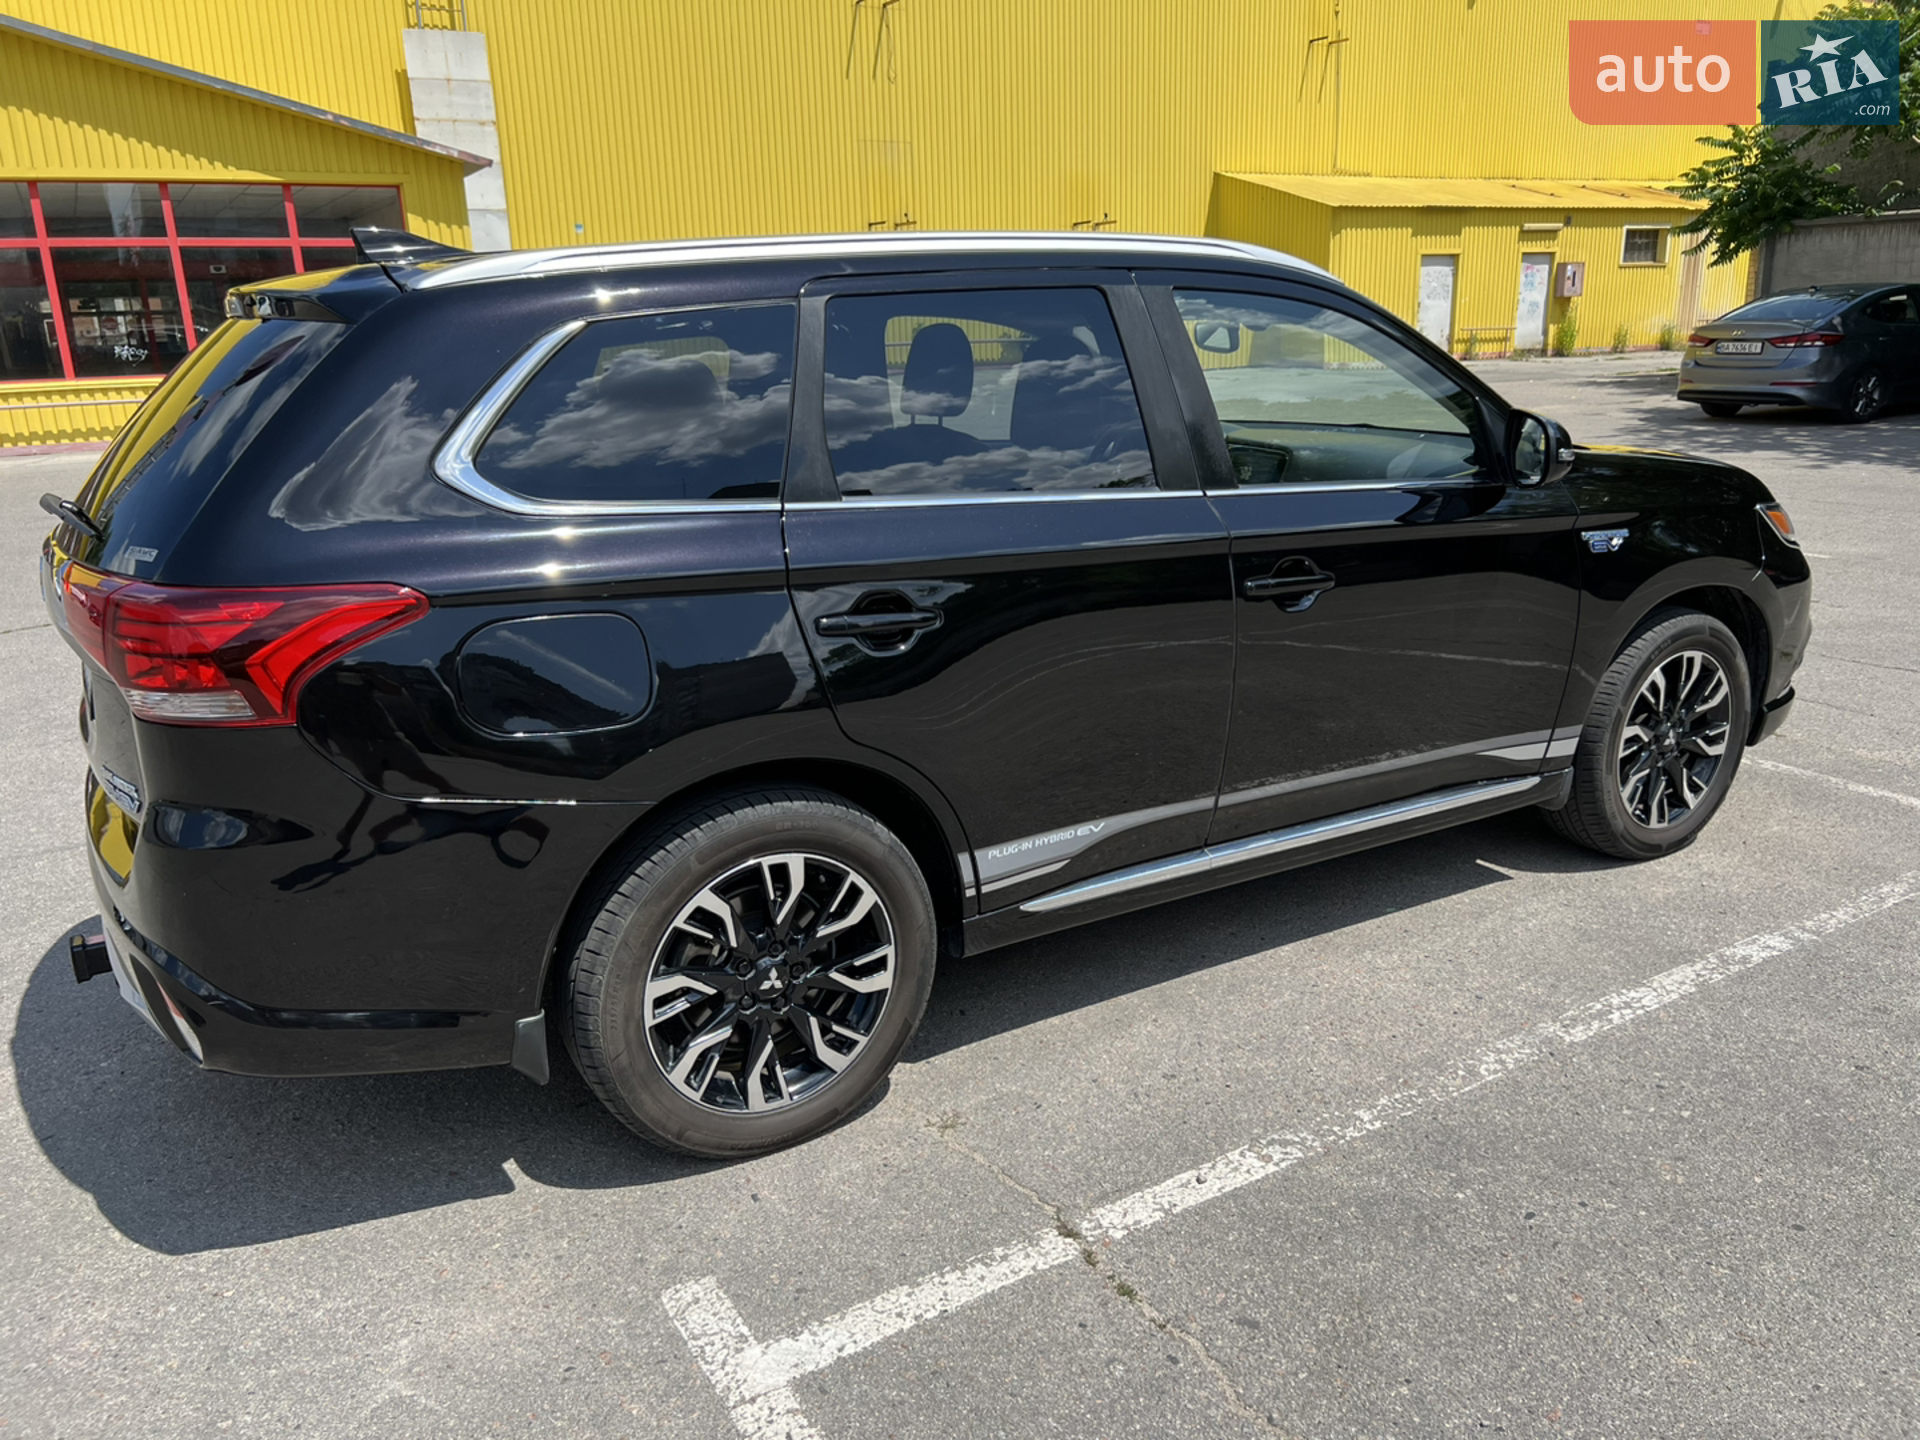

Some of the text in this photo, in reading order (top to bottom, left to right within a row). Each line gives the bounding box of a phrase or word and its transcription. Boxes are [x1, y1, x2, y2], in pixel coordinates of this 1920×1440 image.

[988, 822, 1106, 859] PLUG-IN HYBRID EV
